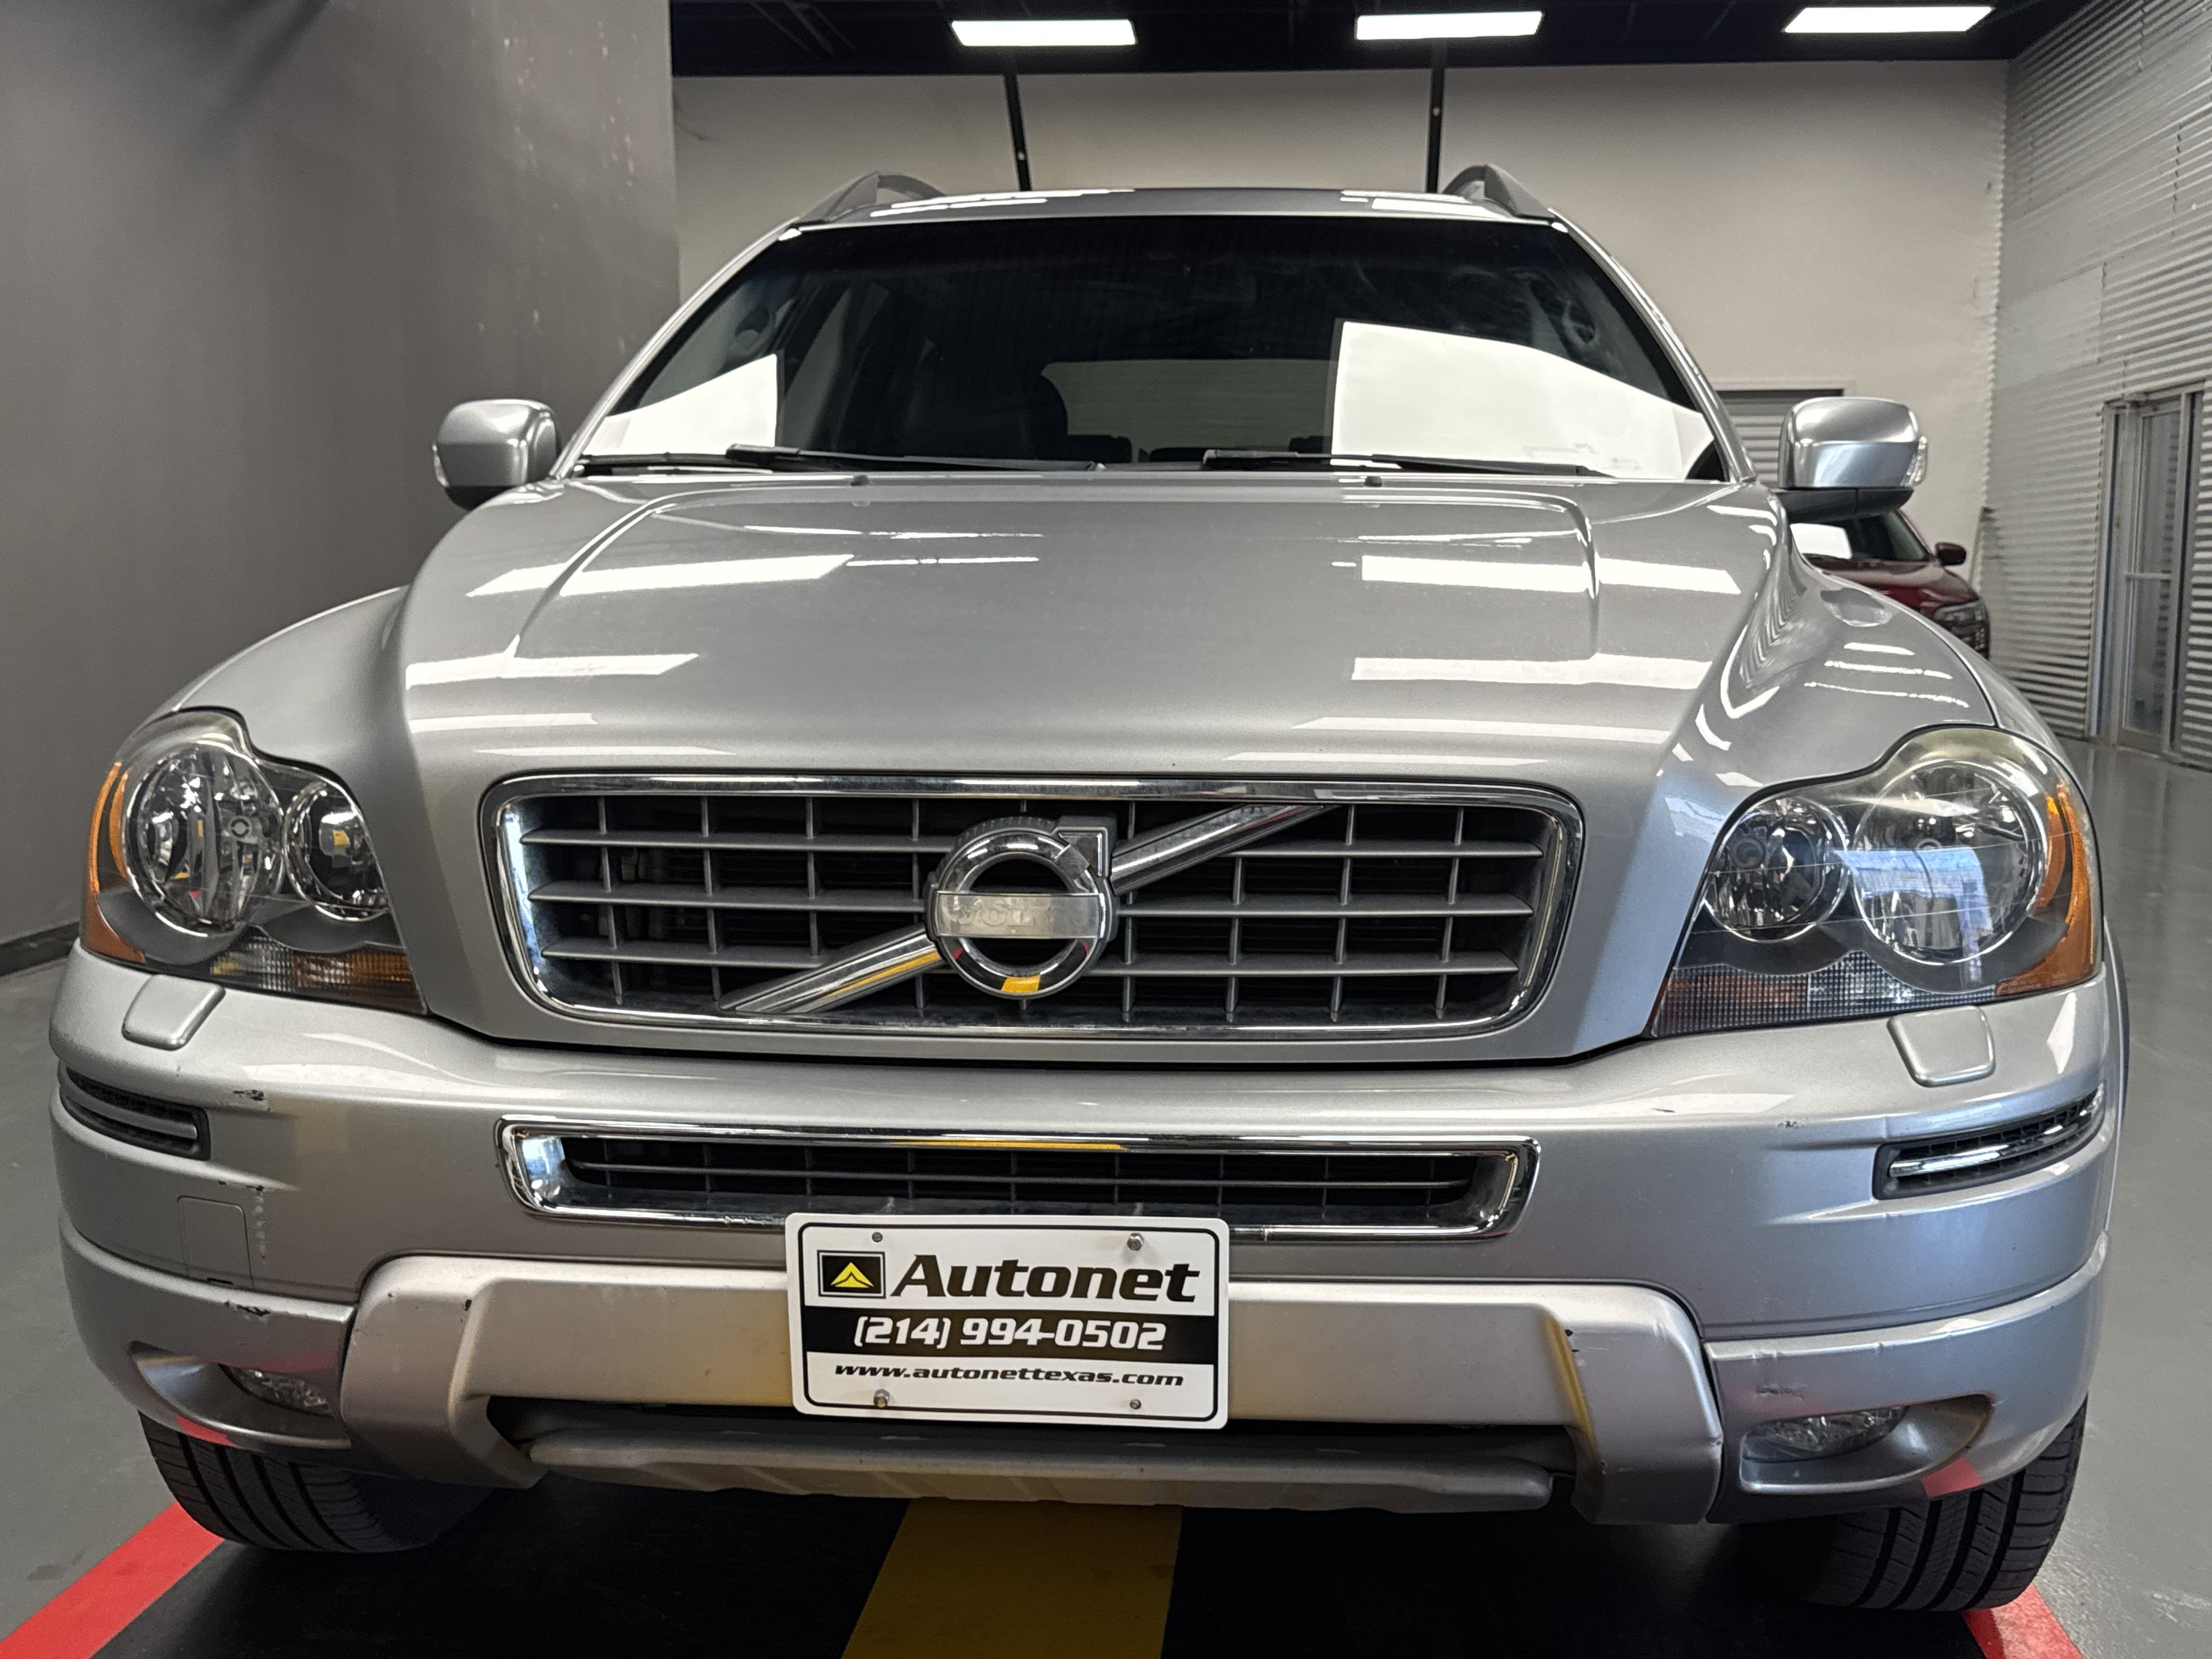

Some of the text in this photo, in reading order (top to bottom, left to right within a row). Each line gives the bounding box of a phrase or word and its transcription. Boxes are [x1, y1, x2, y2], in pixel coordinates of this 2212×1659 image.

[890, 1255, 1200, 1302] Autonet
[854, 1316, 1166, 1350] (214) 994-0502
[834, 1365, 1184, 1386] www.autonettexas.com
